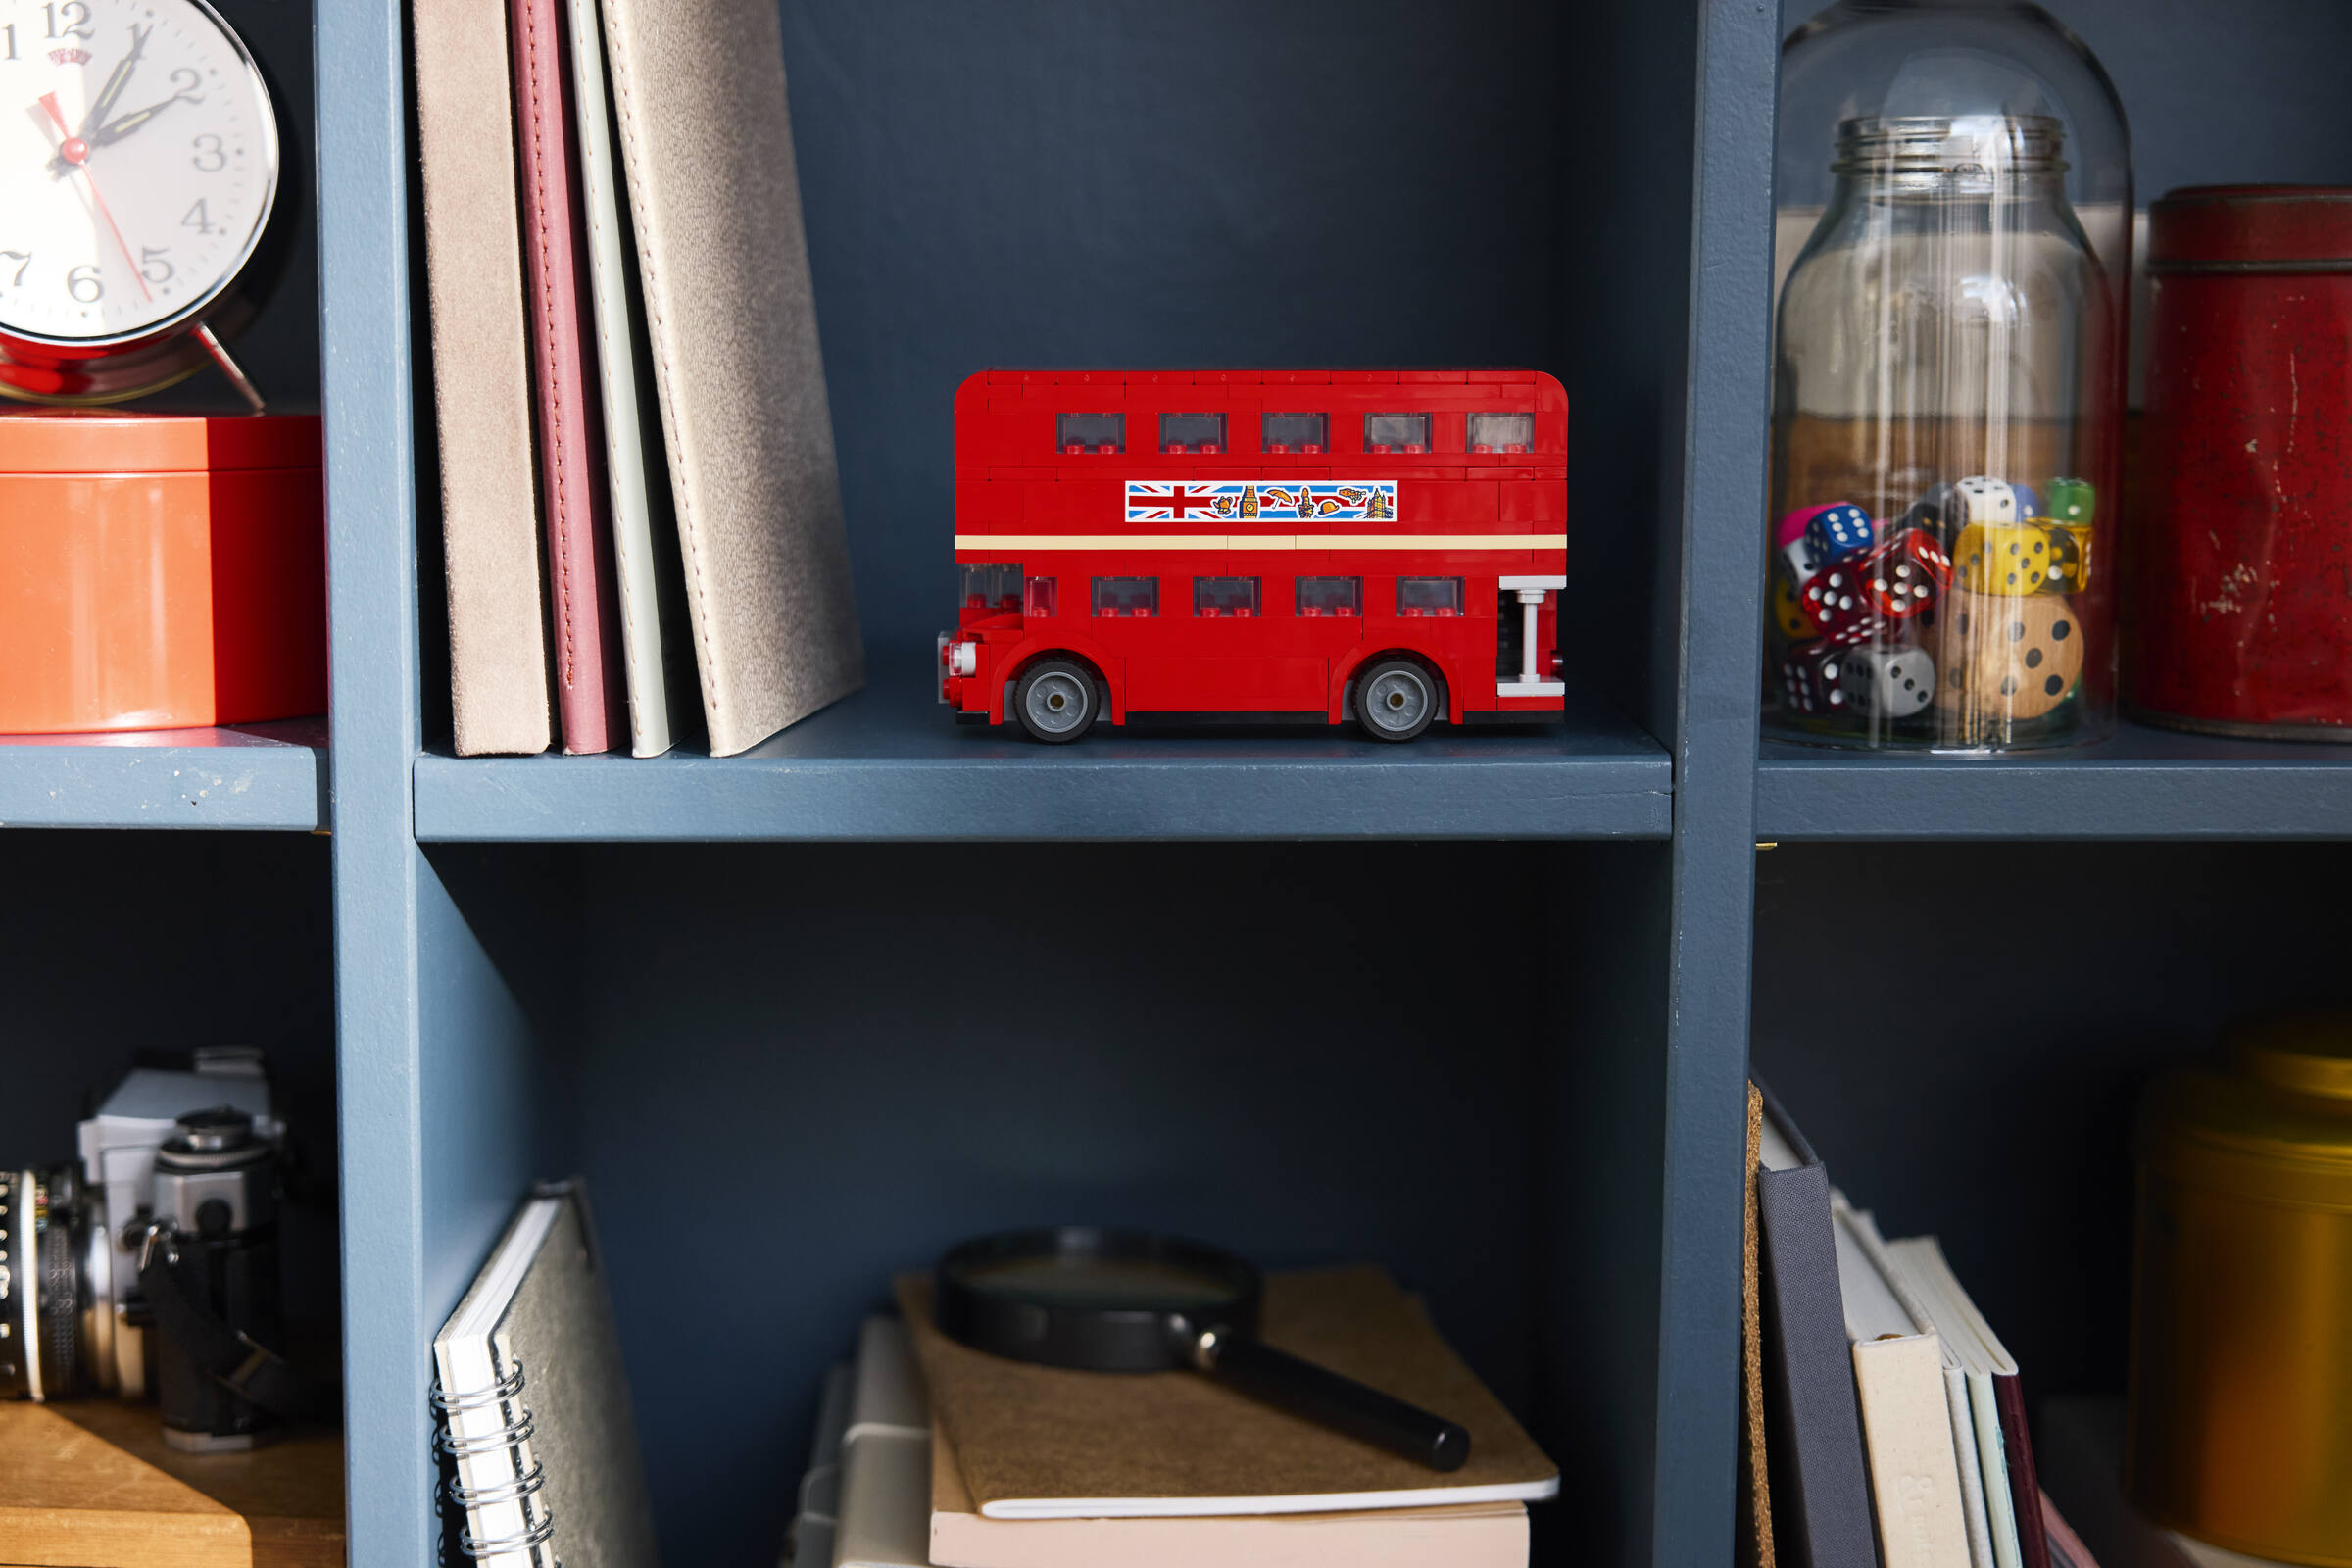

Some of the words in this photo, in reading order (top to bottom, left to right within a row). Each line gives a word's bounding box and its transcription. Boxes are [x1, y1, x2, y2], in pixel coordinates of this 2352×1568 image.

[41, 1, 95, 39] 12
[169, 67, 206, 105] 2
[192, 133, 226, 172] 3
[180, 198, 216, 235] 4
[0, 249, 32, 287] 7
[141, 246, 174, 284] 5
[67, 265, 105, 304] 6
